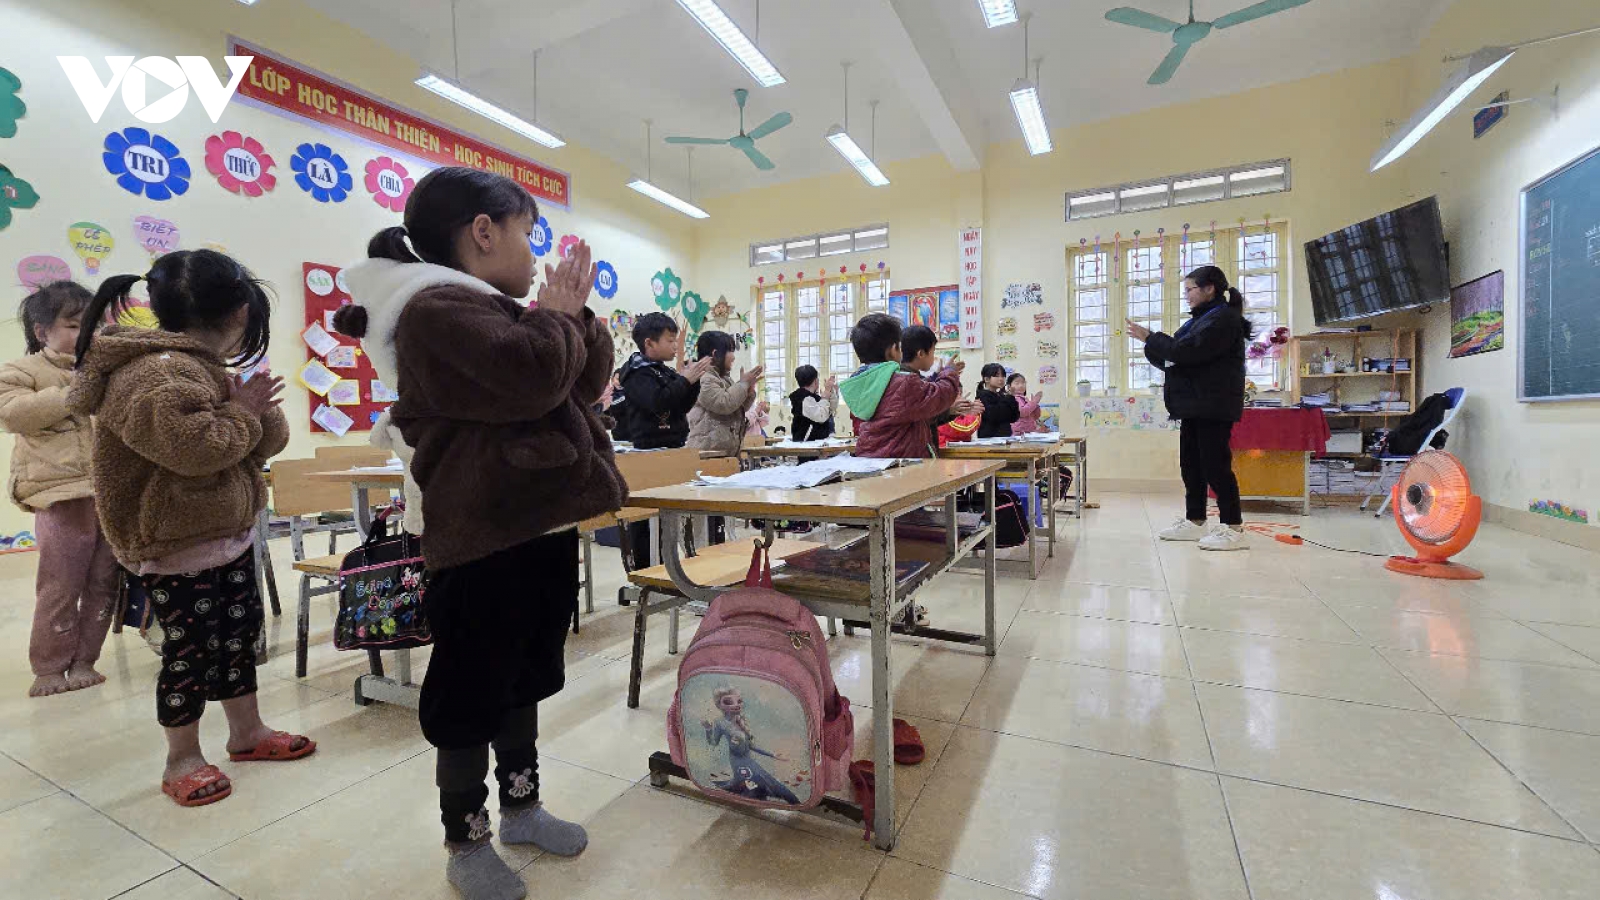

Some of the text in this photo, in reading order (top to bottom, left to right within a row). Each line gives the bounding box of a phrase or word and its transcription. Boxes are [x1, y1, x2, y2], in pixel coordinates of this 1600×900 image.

[129, 151, 165, 176] TRI
[226, 154, 257, 177] THỨC
[310, 163, 333, 183] LÀ
[250, 64, 291, 96] LỚP
[298, 83, 338, 114] HỌC
[343, 101, 390, 135] THÂN
[394, 121, 440, 154] THIỆN
[454, 143, 483, 168] HỌC
[486, 156, 514, 179] SINH
[517, 165, 541, 188] TÍCH
[542, 176, 563, 197] CỰC
